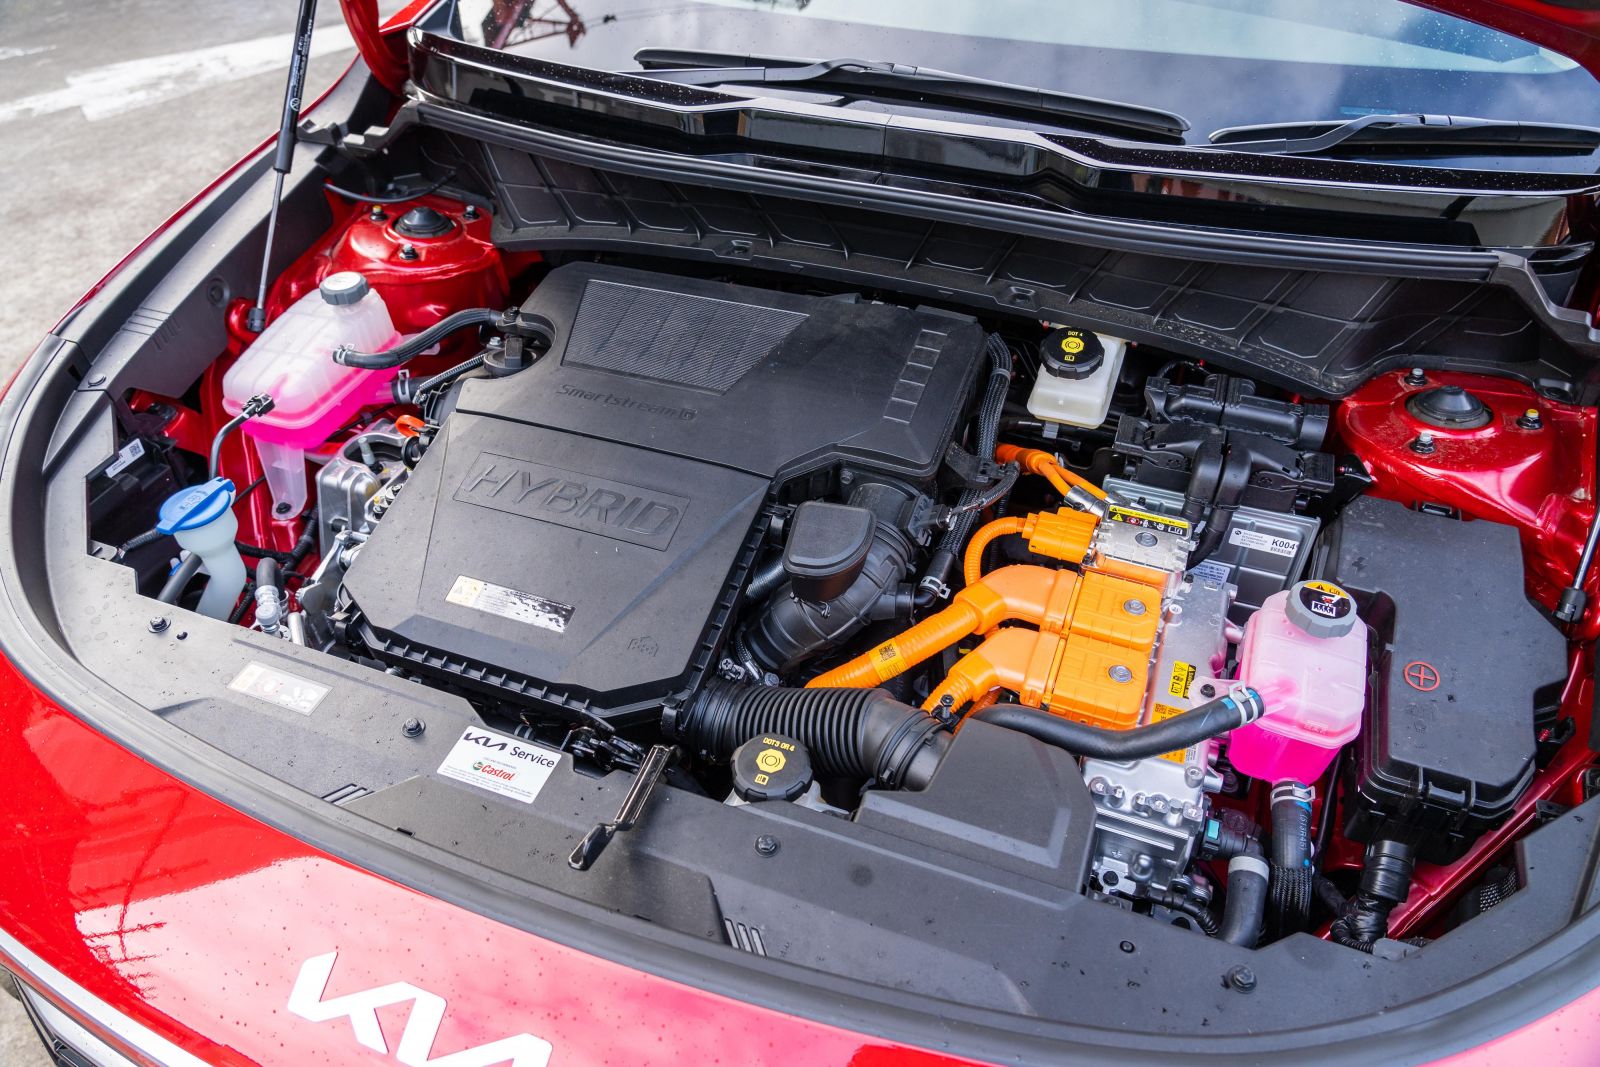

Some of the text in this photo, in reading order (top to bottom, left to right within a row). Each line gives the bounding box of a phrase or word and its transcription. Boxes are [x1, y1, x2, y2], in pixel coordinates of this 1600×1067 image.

[555, 384, 676, 416] Smartstream
[463, 464, 680, 536] HYBRID
[1271, 538, 1296, 551] K004
[510, 746, 555, 768] Service
[481, 764, 516, 781] Castrol
